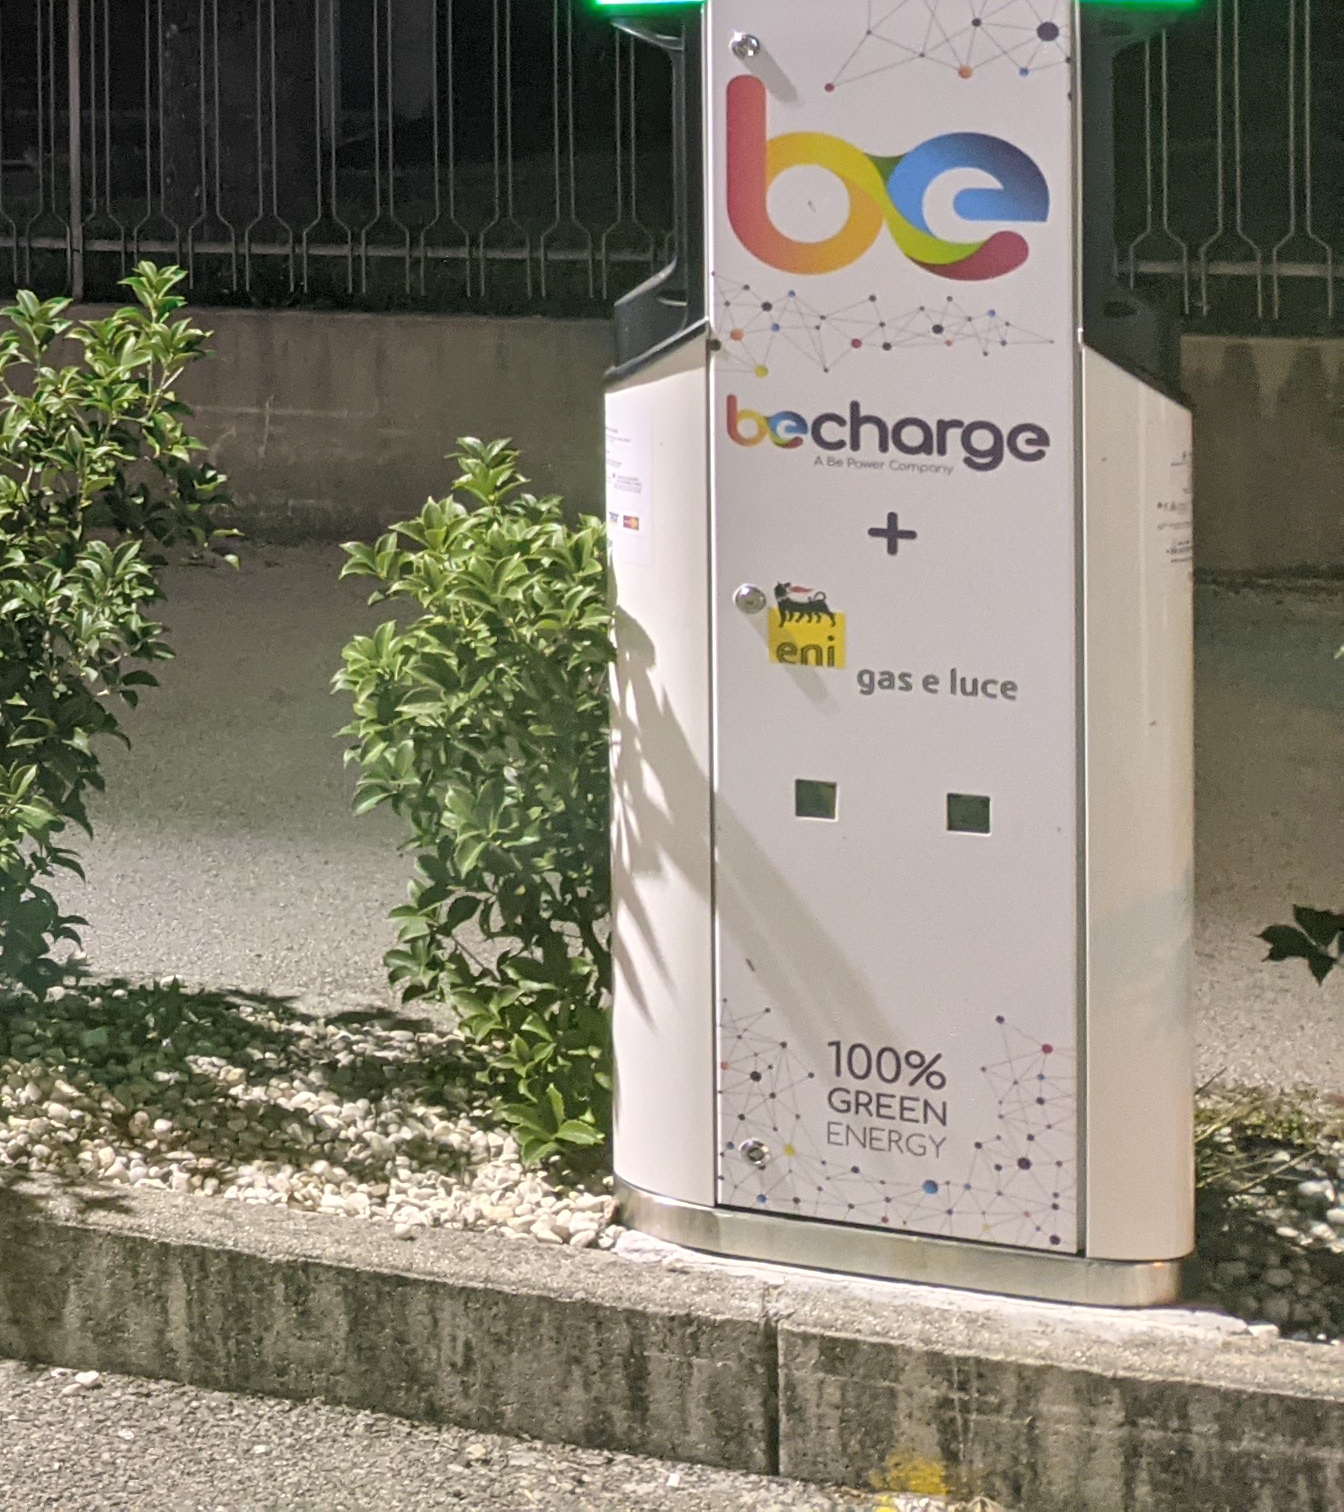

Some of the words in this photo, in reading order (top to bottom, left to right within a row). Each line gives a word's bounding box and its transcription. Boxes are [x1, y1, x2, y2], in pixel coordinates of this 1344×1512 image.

[726, 74, 1050, 281] be
[726, 394, 1050, 471] becharge
[814, 455, 823, 466] A
[827, 456, 844, 467] Be
[847, 457, 885, 470] Power
[889, 459, 954, 476] Company
[776, 634, 835, 668] eni
[857, 669, 912, 695] gas
[921, 673, 940, 694] e
[950, 668, 1018, 701] luce
[828, 1040, 947, 1090] 100%
[827, 1087, 947, 1127] GREEN
[826, 1121, 947, 1159] ENERGY
